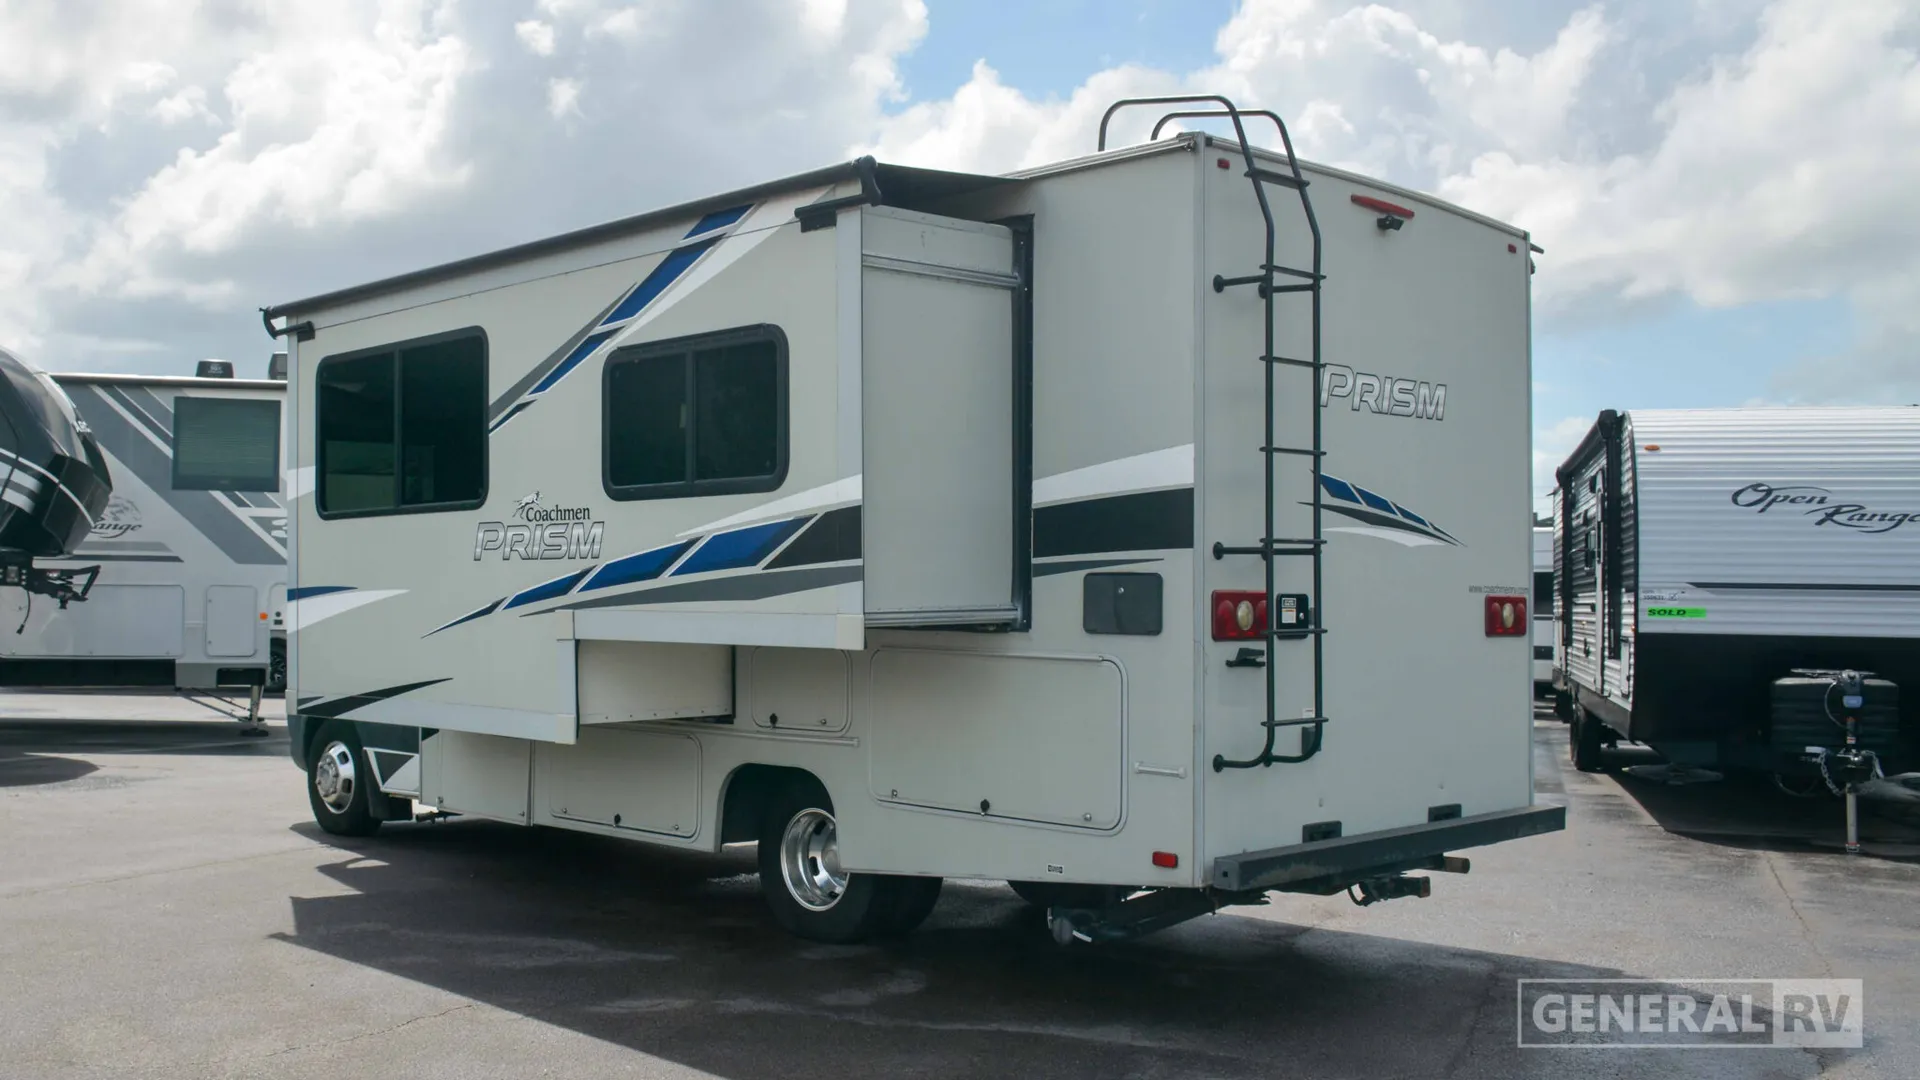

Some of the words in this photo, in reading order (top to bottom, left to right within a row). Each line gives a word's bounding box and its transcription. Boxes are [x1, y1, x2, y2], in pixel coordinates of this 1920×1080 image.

[1319, 362, 1447, 421] PRISM
[525, 504, 591, 522] Coachmen
[1731, 482, 1832, 513] Open
[473, 521, 605, 561] PRISM
[1647, 608, 1686, 617] SOLD
